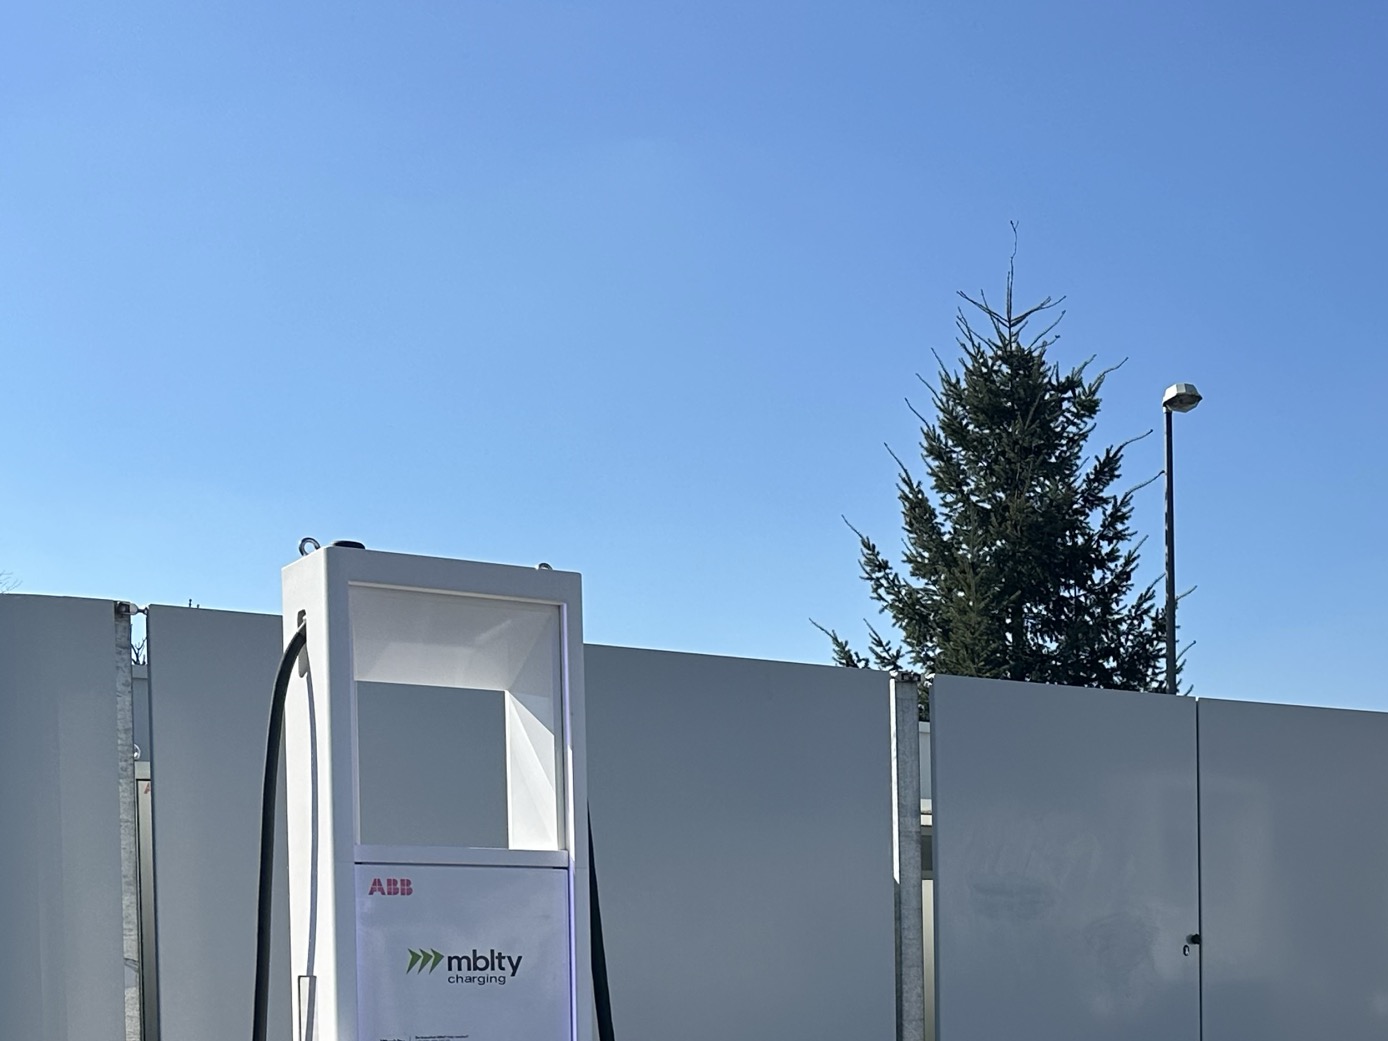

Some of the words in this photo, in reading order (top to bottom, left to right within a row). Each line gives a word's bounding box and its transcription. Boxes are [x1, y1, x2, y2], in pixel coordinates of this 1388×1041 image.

[368, 878, 413, 896] ABB
[447, 949, 523, 977] mblty
[447, 974, 506, 985] charging
